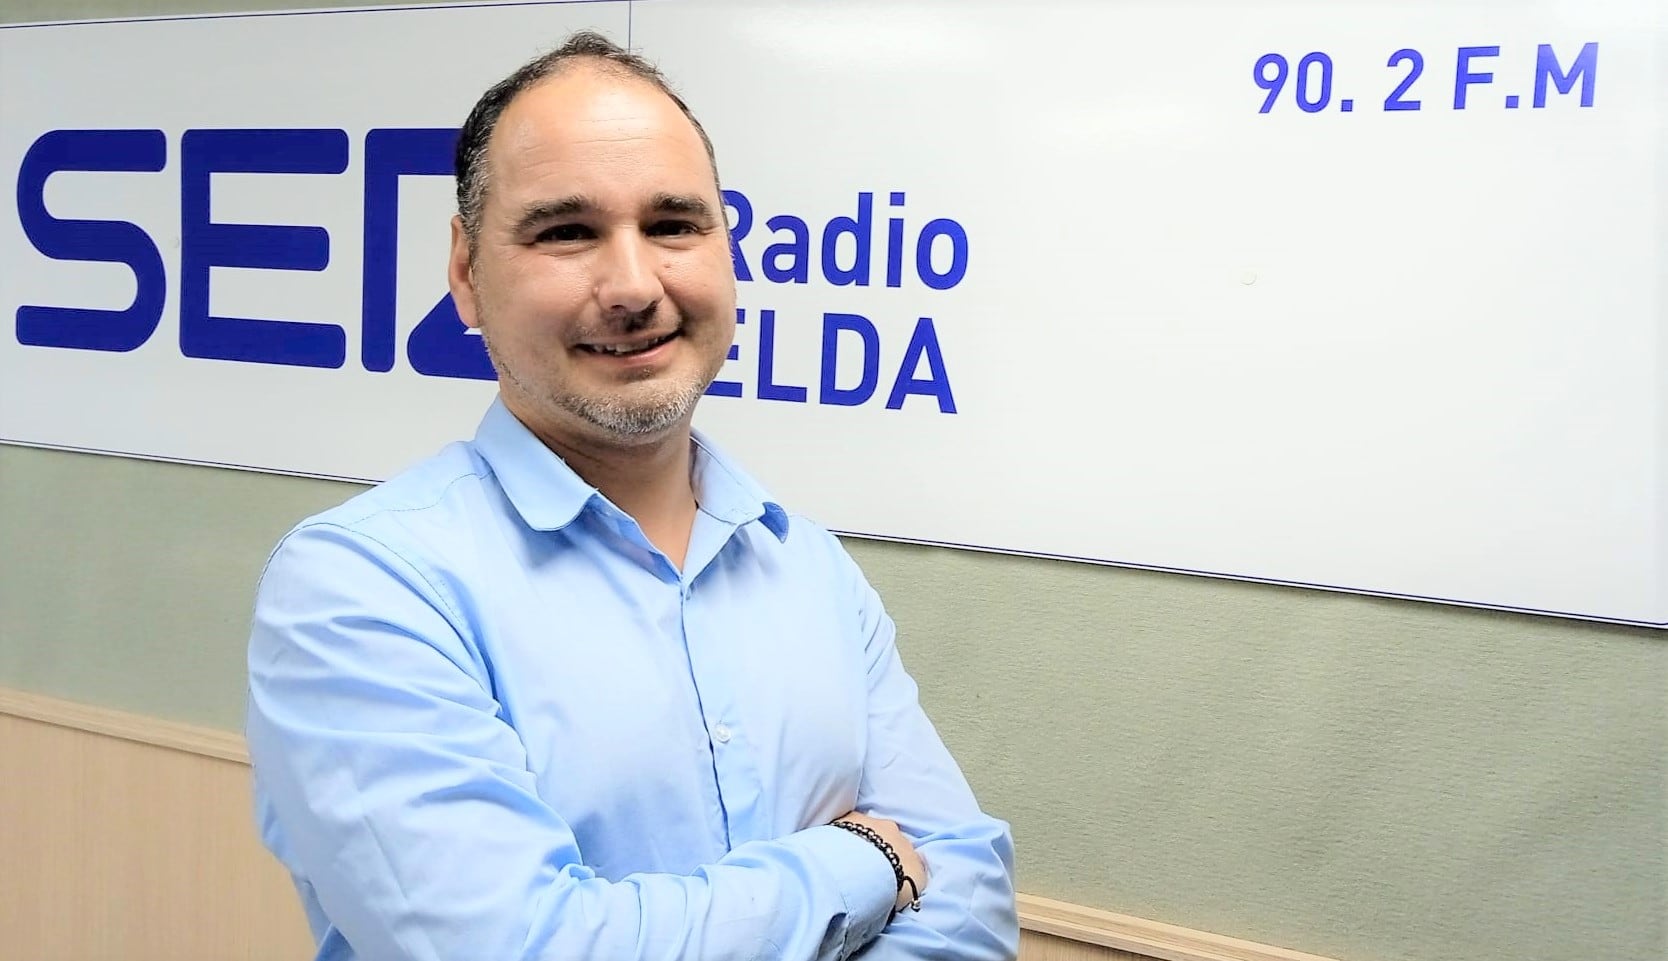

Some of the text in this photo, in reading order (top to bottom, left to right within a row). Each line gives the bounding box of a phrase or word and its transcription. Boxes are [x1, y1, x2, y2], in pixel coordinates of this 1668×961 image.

[1253, 42, 1600, 113] 90. 2 F.M
[720, 189, 969, 291] Radio
